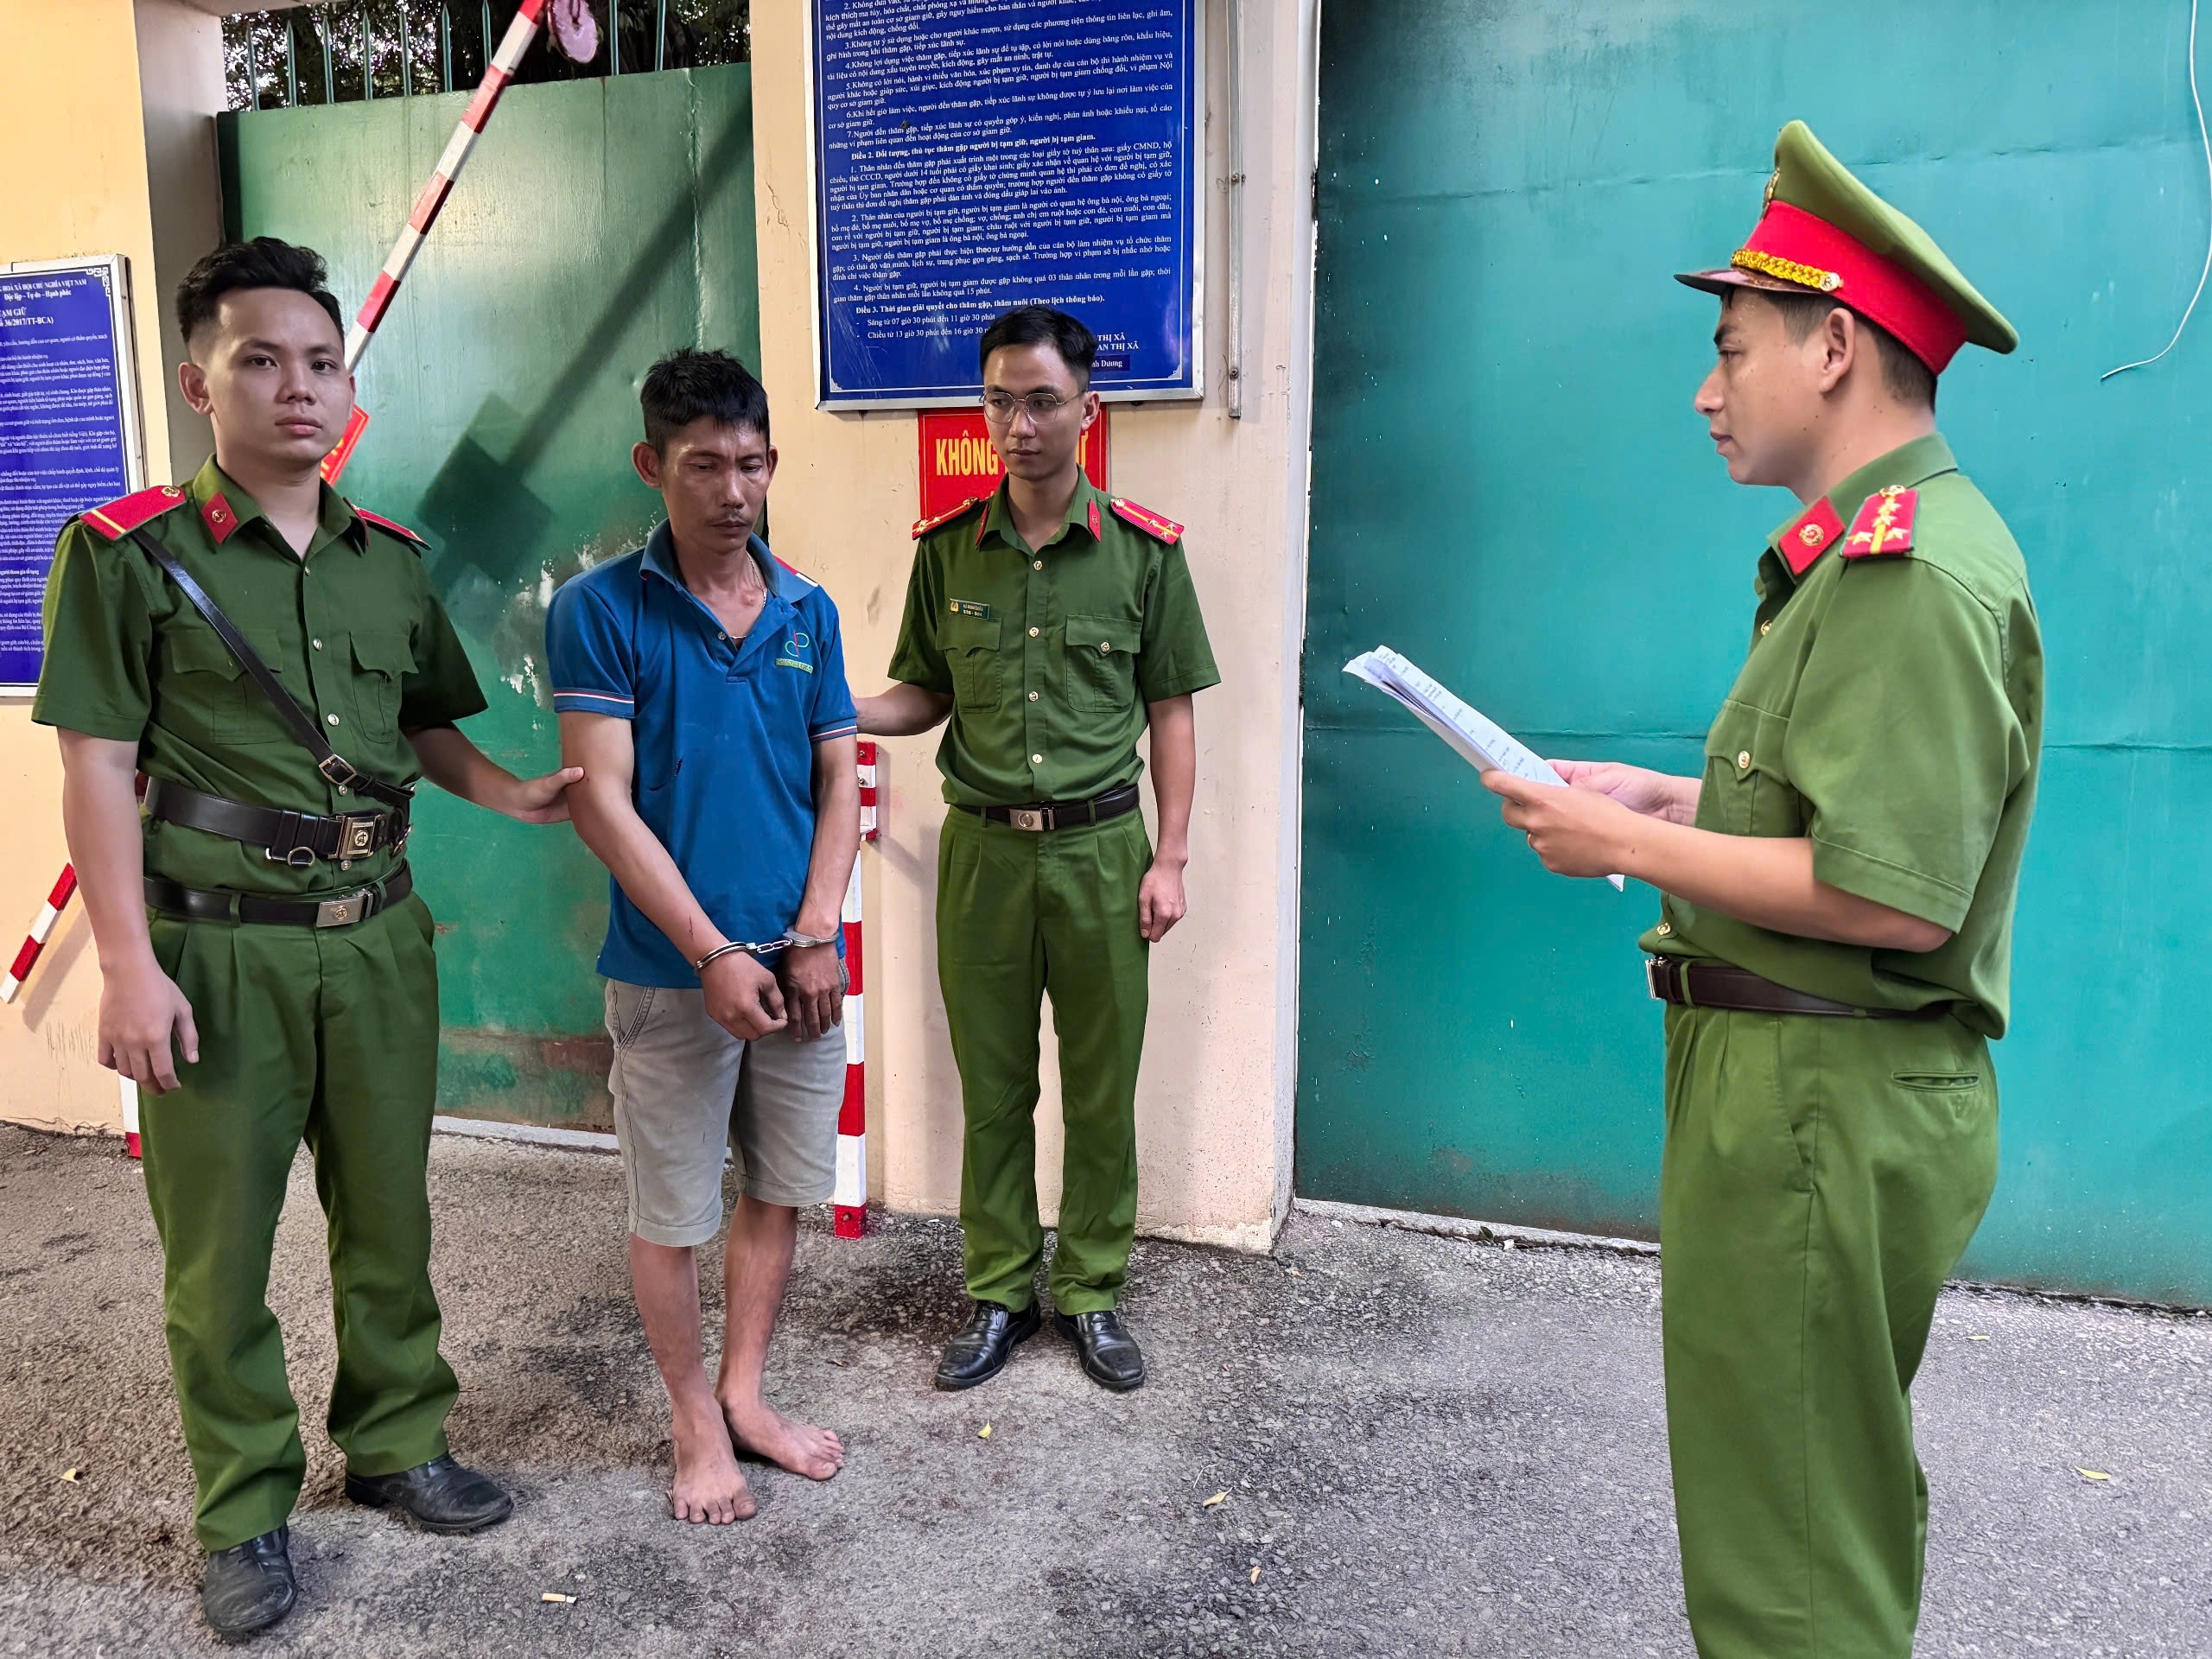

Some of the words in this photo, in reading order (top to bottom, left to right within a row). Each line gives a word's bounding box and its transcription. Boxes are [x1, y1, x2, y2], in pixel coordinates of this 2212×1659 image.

[851, 150, 866, 160] Điều
[875, 149, 887, 157] Đối
[955, 143, 968, 152] gặp
[969, 141, 989, 150] người
[990, 140, 998, 149] bị
[1014, 138, 1027, 147] giữ,
[1029, 136, 1050, 146] người
[1052, 136, 1058, 144] bị
[1076, 133, 1096, 143] giam.
[855, 304, 870, 314] Điều
[896, 304, 911, 313] gian
[912, 303, 924, 312] giải
[925, 301, 944, 311] quyết
[1029, 297, 1050, 306] (Theo
[1051, 296, 1064, 305] lịch
[1065, 295, 1085, 303] thông
[1087, 294, 1104, 302] báo).
[900, 316, 911, 326] giờ
[921, 315, 935, 324] phút
[937, 314, 949, 322] đến
[959, 314, 970, 322] giờ
[981, 313, 995, 321] phút
[868, 329, 886, 338] Chiều
[904, 329, 914, 338] giờ
[925, 328, 939, 337] phút
[940, 327, 952, 335] đến
[963, 327, 973, 335] giờ
[1114, 332, 1125, 340] XÃ
[1127, 340, 1139, 349] XÃ
[936, 429, 998, 476] KHÔNG
